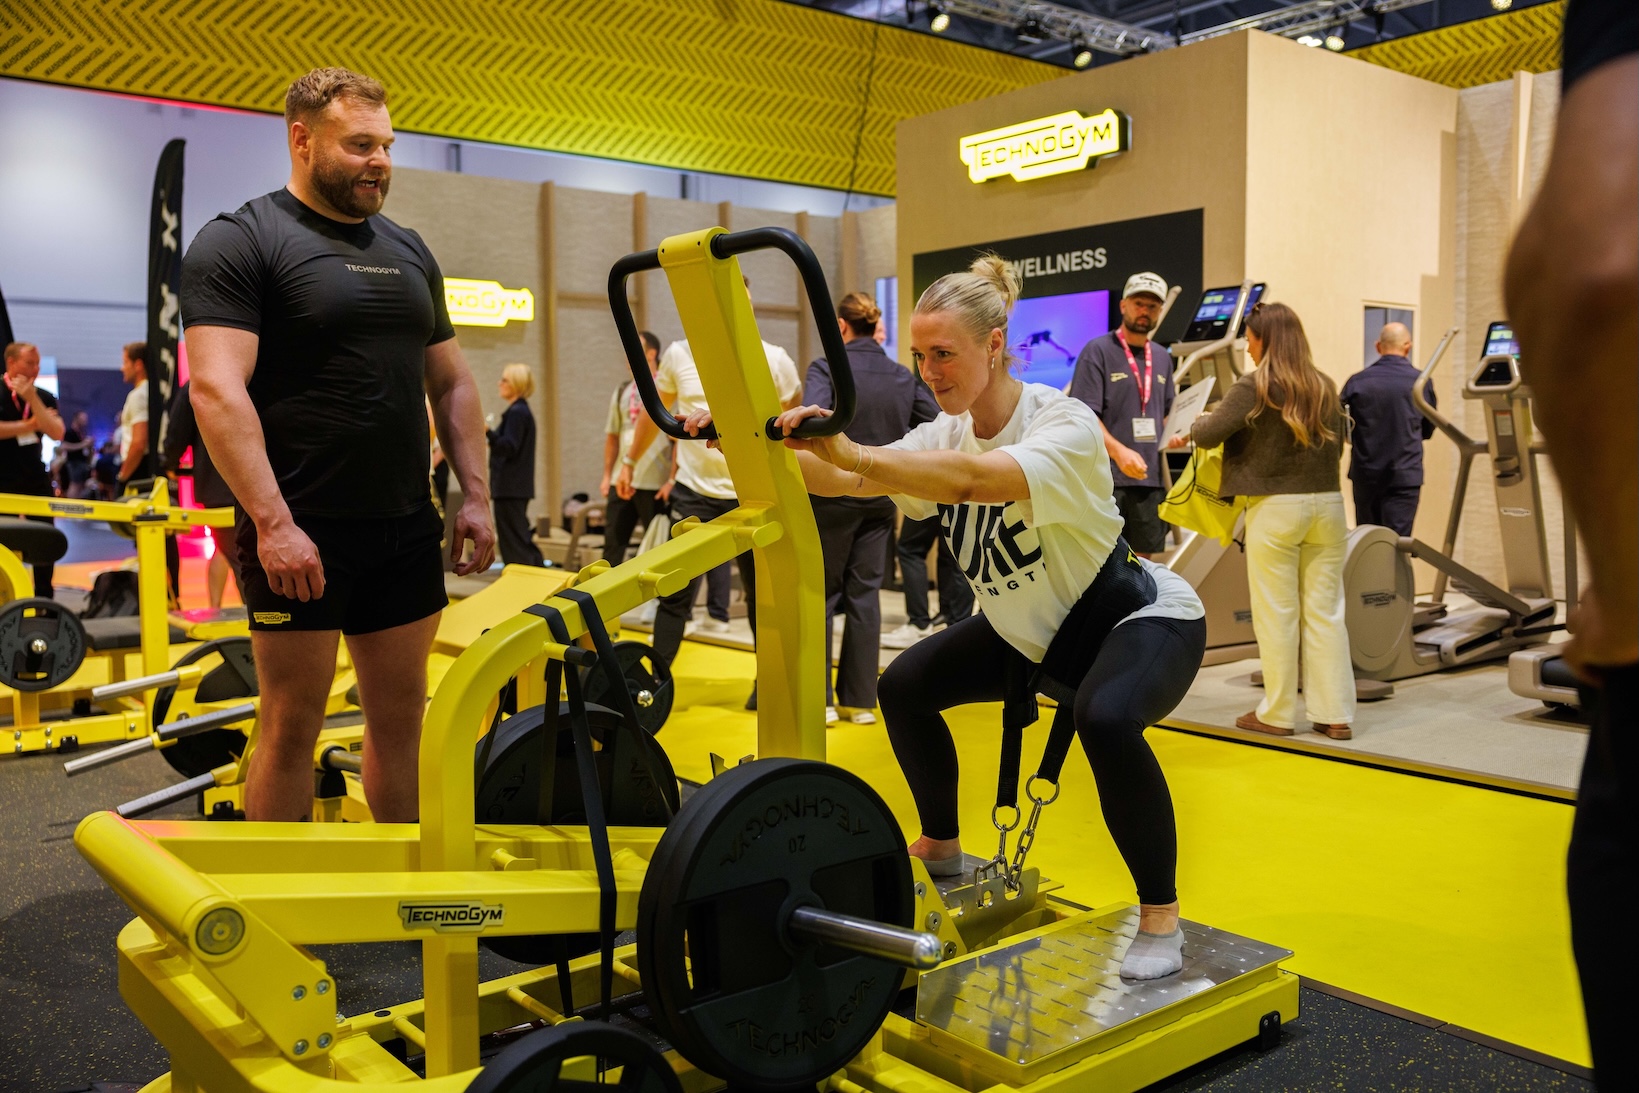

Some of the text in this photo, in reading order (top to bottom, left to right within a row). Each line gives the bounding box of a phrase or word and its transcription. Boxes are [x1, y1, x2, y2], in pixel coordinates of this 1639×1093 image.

[966, 122, 1111, 171] TECHNOGYM
[345, 264, 401, 275] TECHNOGYM
[1010, 247, 1107, 277] WELLNESS
[720, 795, 870, 866] TECHNOGYM
[402, 905, 503, 926] TECHNOGYM
[725, 976, 876, 1057] TECHNOGYM
